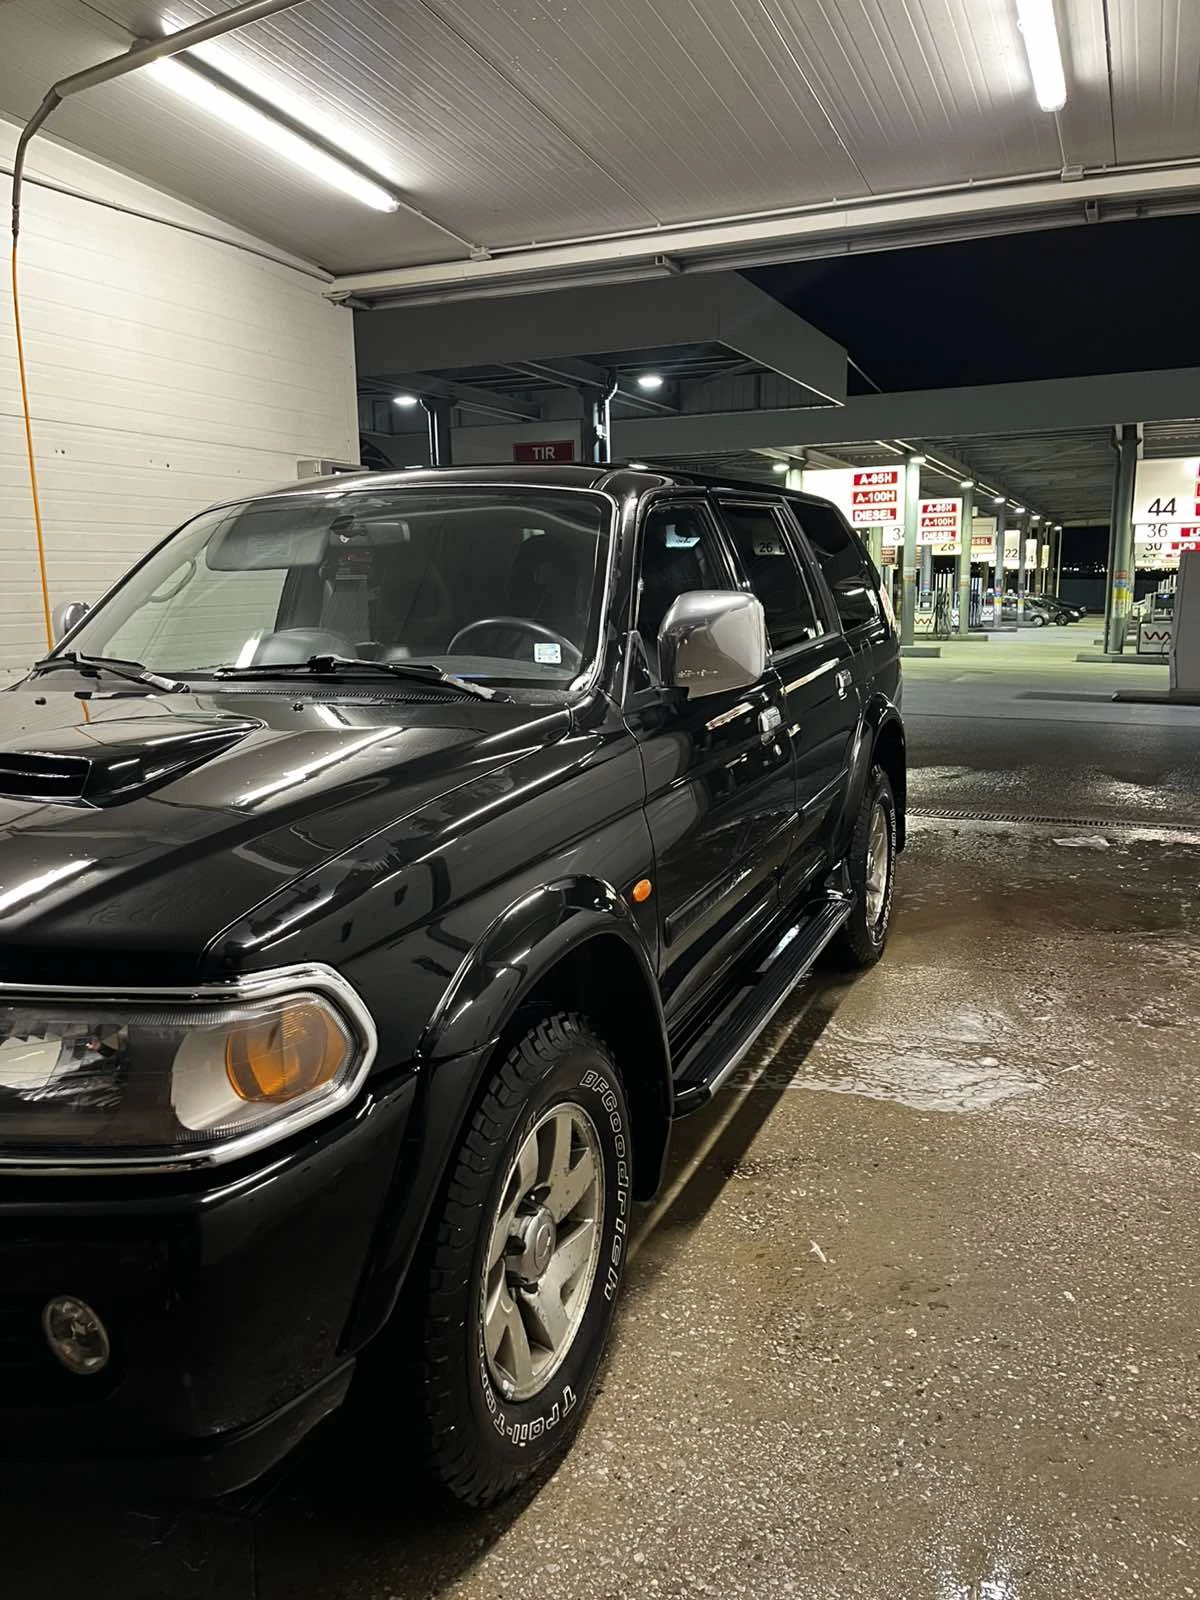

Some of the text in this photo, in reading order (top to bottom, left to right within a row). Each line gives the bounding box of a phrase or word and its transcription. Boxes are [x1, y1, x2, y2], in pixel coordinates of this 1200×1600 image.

[532, 446, 555, 460] TIR
[856, 491, 895, 503] A-100H
[1148, 498, 1177, 516] 44
[854, 509, 894, 521] DIESEL
[924, 517, 954, 526] A-100H
[892, 527, 905, 541] 3
[1147, 523, 1168, 538] 36
[759, 542, 774, 553] 26
[1005, 548, 1018, 558] 22
[579, 1069, 630, 1301] BFGoodrich
